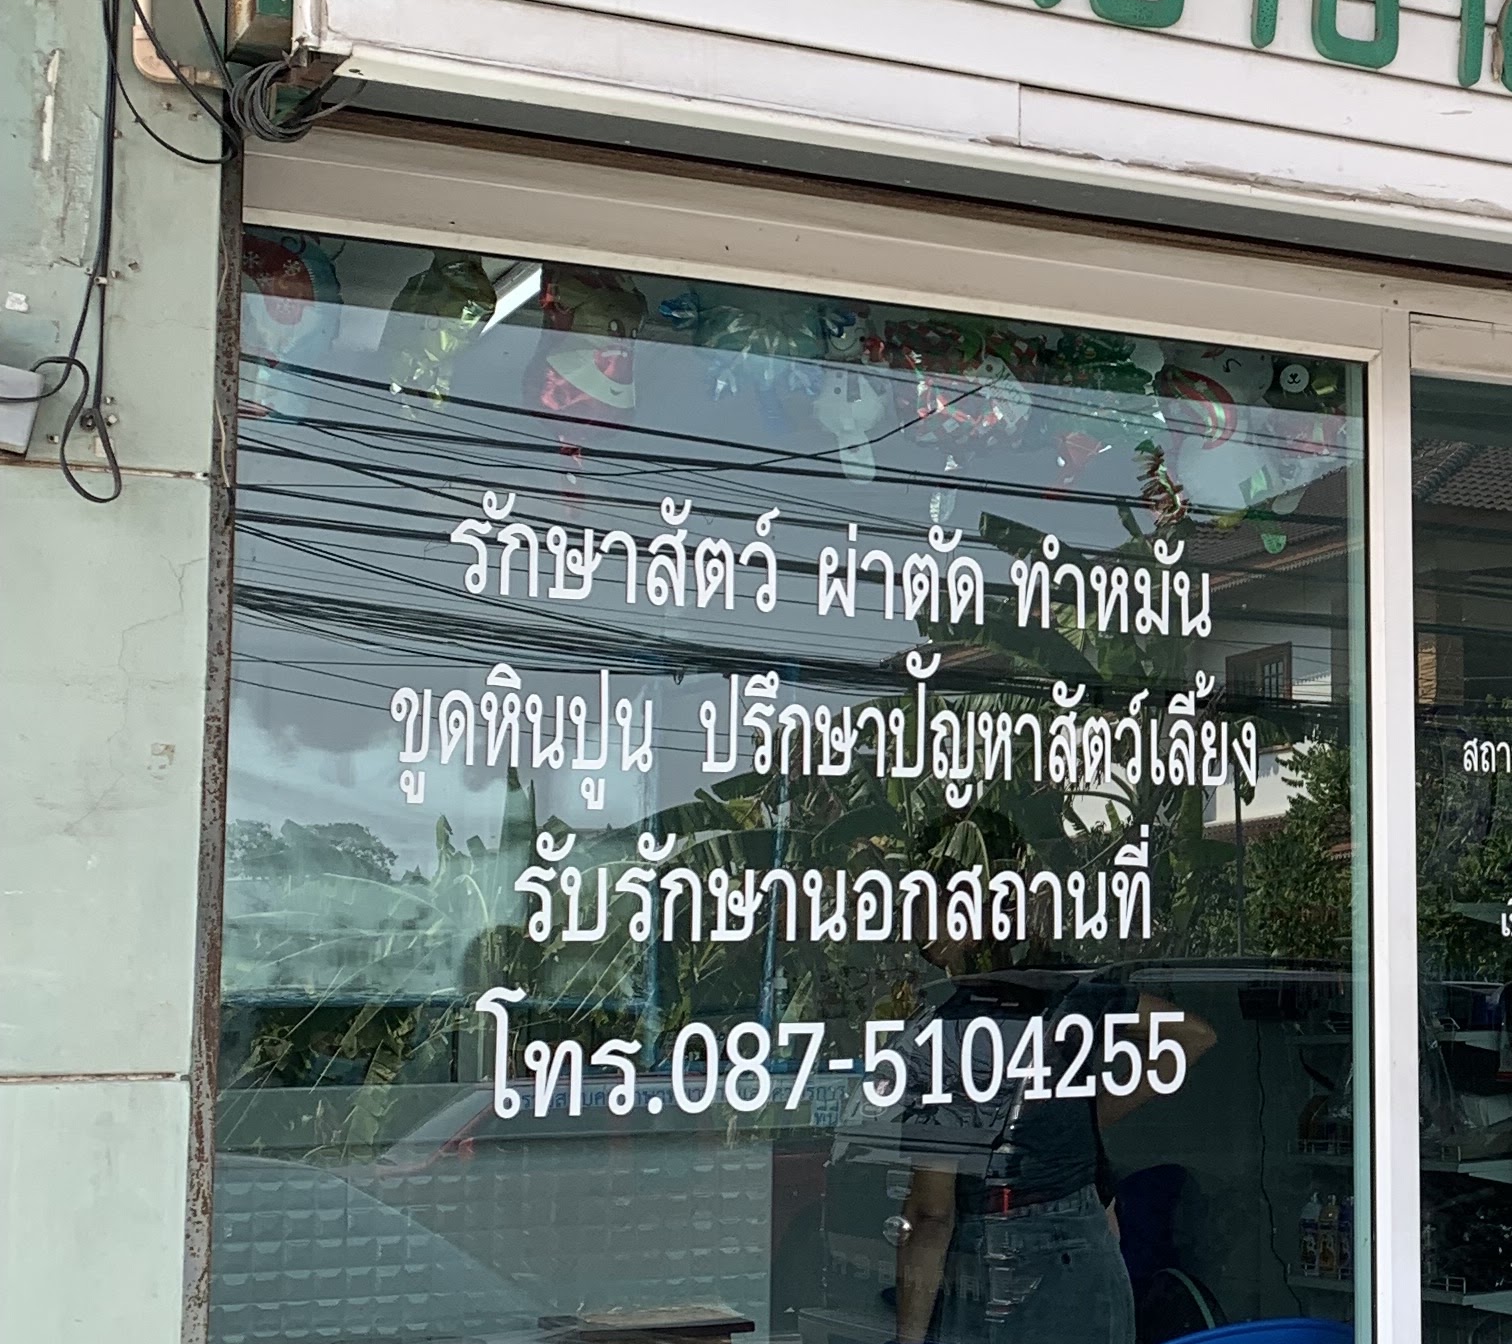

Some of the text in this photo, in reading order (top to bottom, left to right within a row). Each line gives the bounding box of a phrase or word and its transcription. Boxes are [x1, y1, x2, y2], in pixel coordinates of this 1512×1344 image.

[450, 490, 1212, 638] รักษาสัตว์ ผ่าตัด ทำหมัน
[390, 650, 1260, 811] ขูดหินปูน ปรึกษาปัญหาสัตว์เลี้ยง
[514, 825, 1151, 942] รับรักษานอกสถานที่
[475, 986, 1187, 1119] โทร.087-5104255
